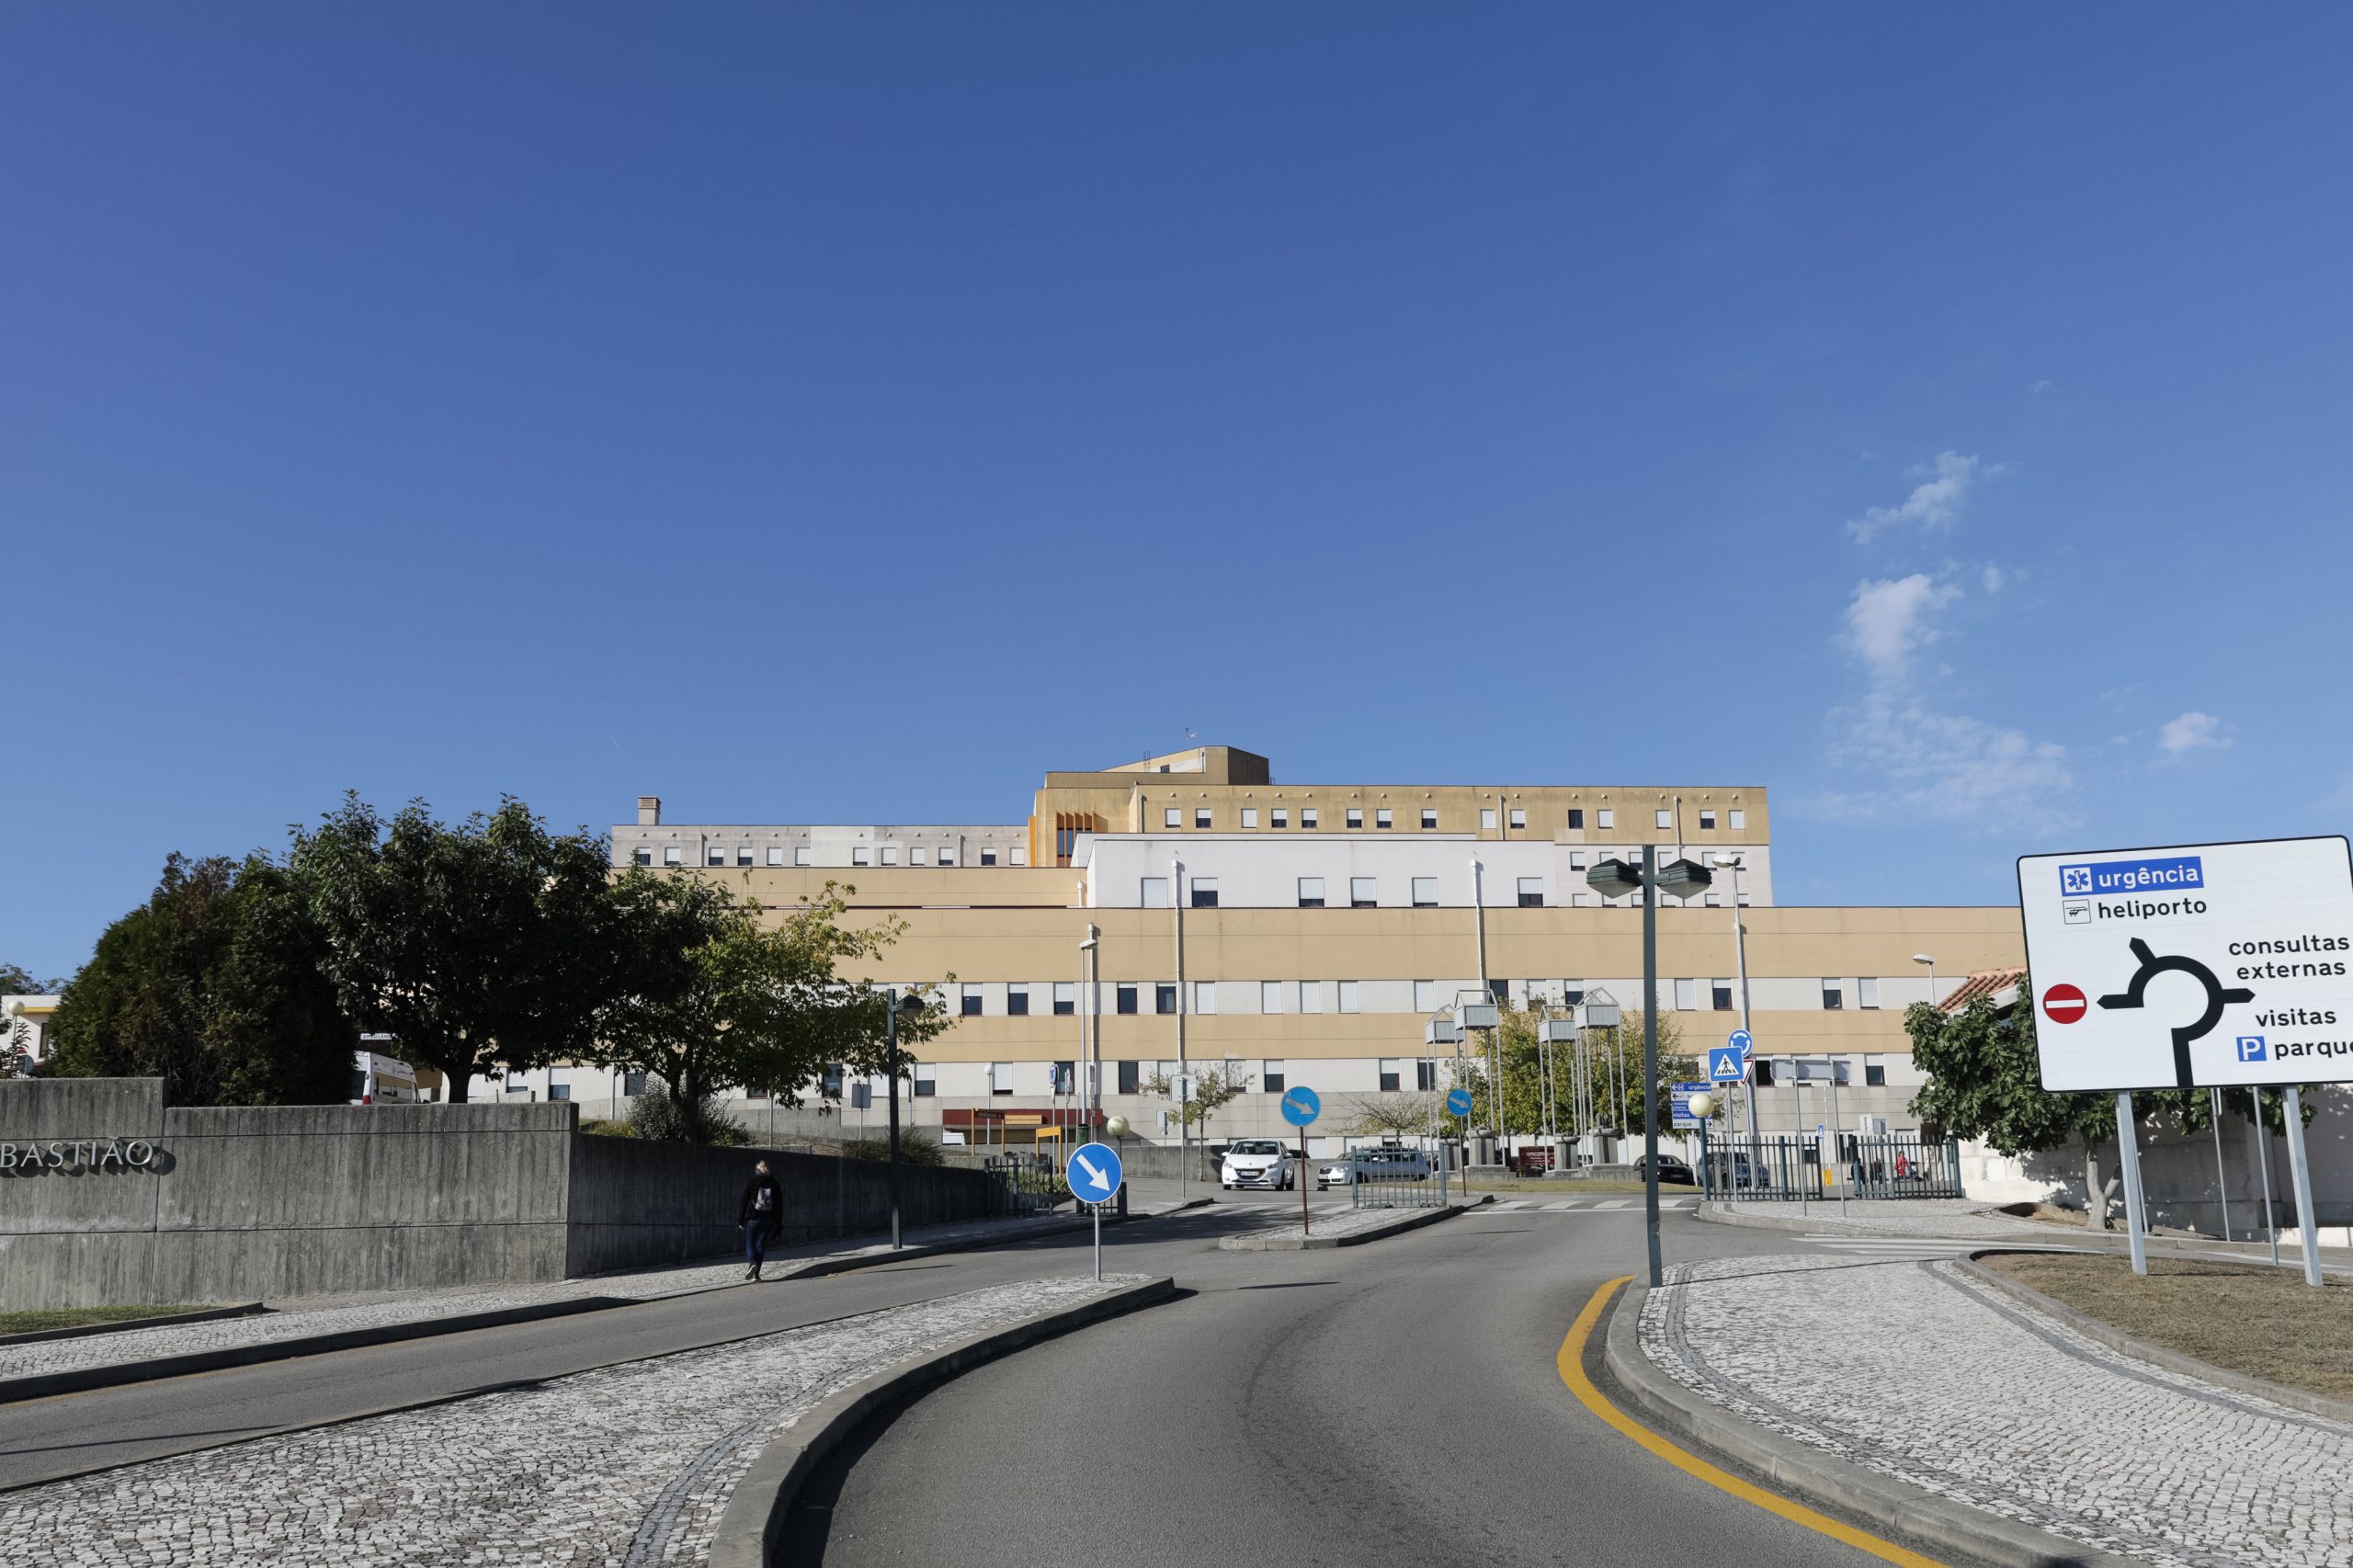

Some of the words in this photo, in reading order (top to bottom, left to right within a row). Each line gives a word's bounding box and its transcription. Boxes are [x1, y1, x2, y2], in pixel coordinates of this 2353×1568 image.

[2098, 865, 2199, 889] urgência
[2098, 897, 2207, 919] heliporto
[2229, 935, 2350, 956] consultas
[2236, 961, 2346, 980] externas
[2256, 1008, 2336, 1027] visitas
[2274, 1041, 2353, 1060] parqu
[0, 1136, 153, 1168] BASTIÃO
